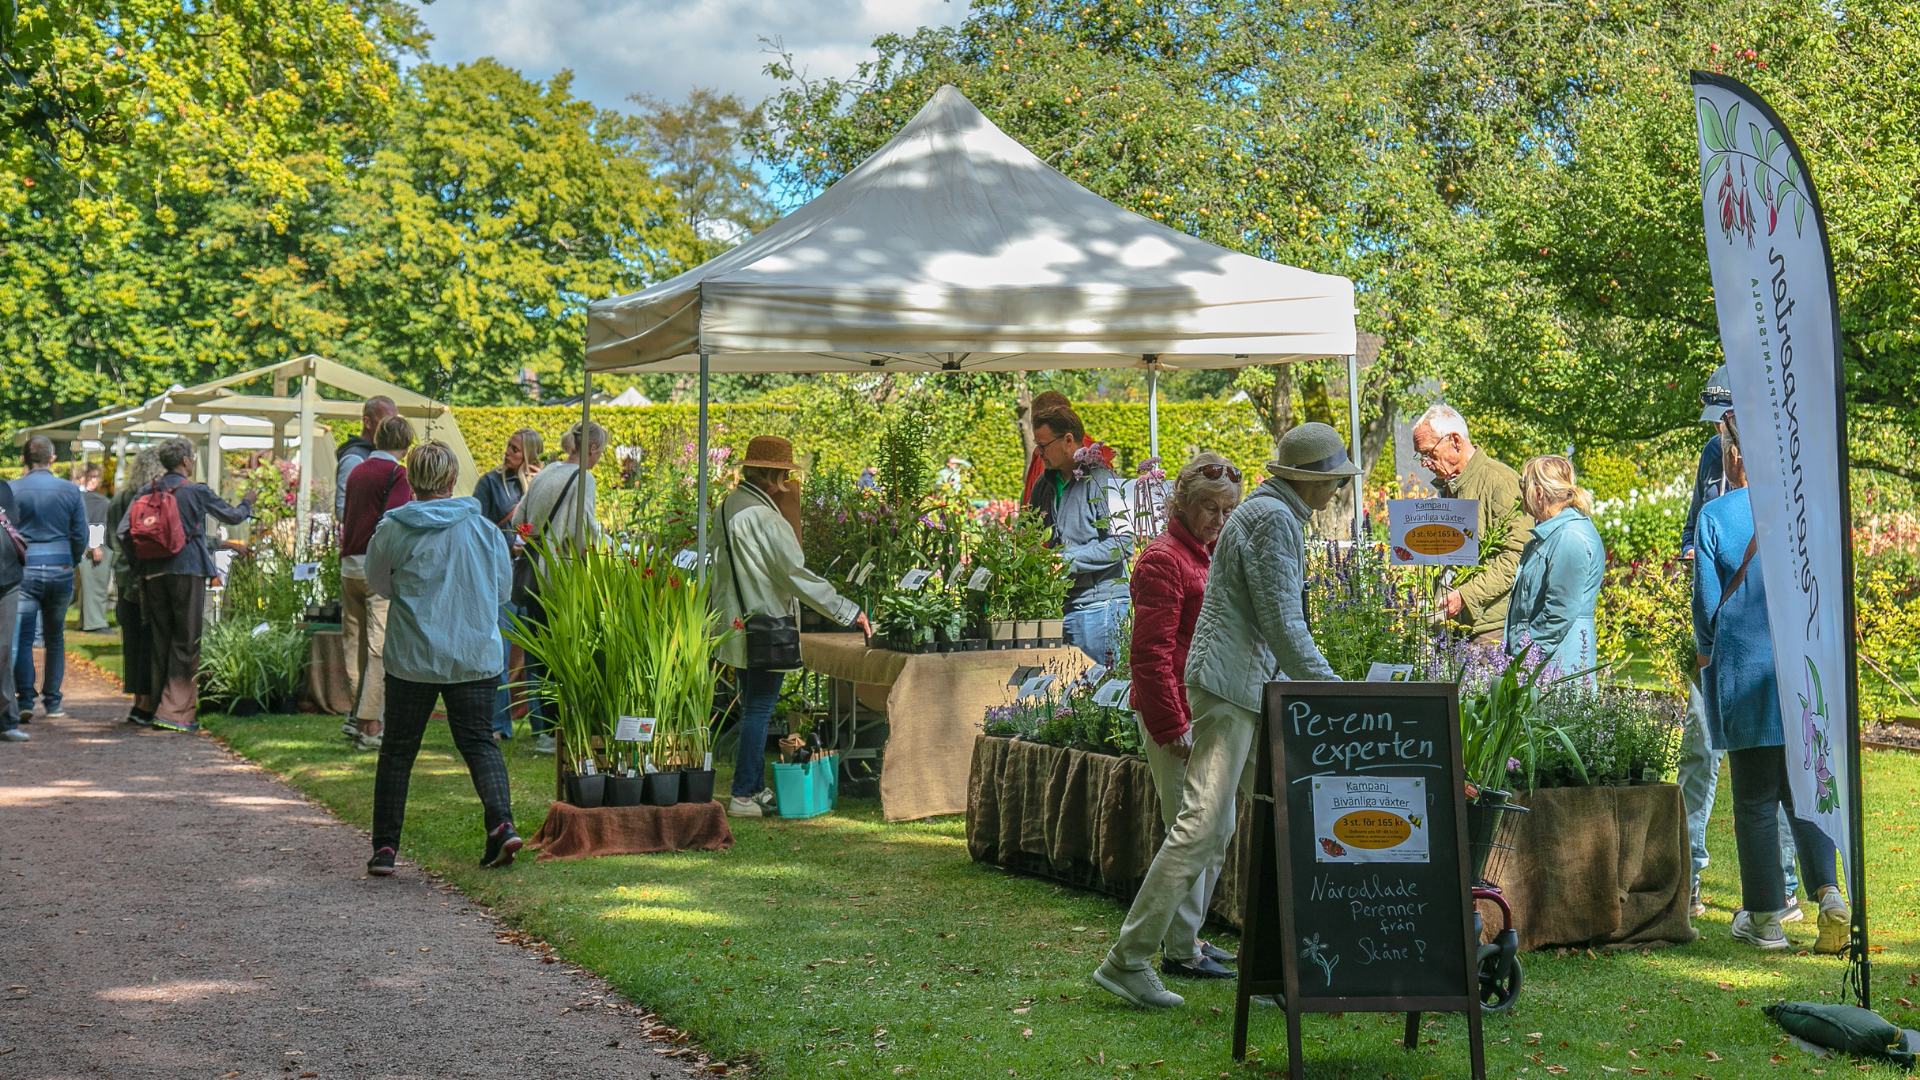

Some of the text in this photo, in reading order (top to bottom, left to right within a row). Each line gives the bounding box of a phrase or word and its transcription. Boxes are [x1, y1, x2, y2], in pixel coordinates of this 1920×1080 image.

[1415, 502, 1450, 510] Kampanj
[1405, 513, 1466, 522] Bivänliga växter
[1312, 731, 1433, 770] experten
[1346, 782, 1389, 792] Kampanj
[1333, 796, 1410, 807] Bivänliga växter
[1343, 818, 1348, 826] 3
[1363, 818, 1375, 826] för
[1395, 818, 1403, 826] kr
[1311, 873, 1418, 901] Närodlade
[1350, 900, 1429, 921] Perenner
[1380, 919, 1416, 935] från
